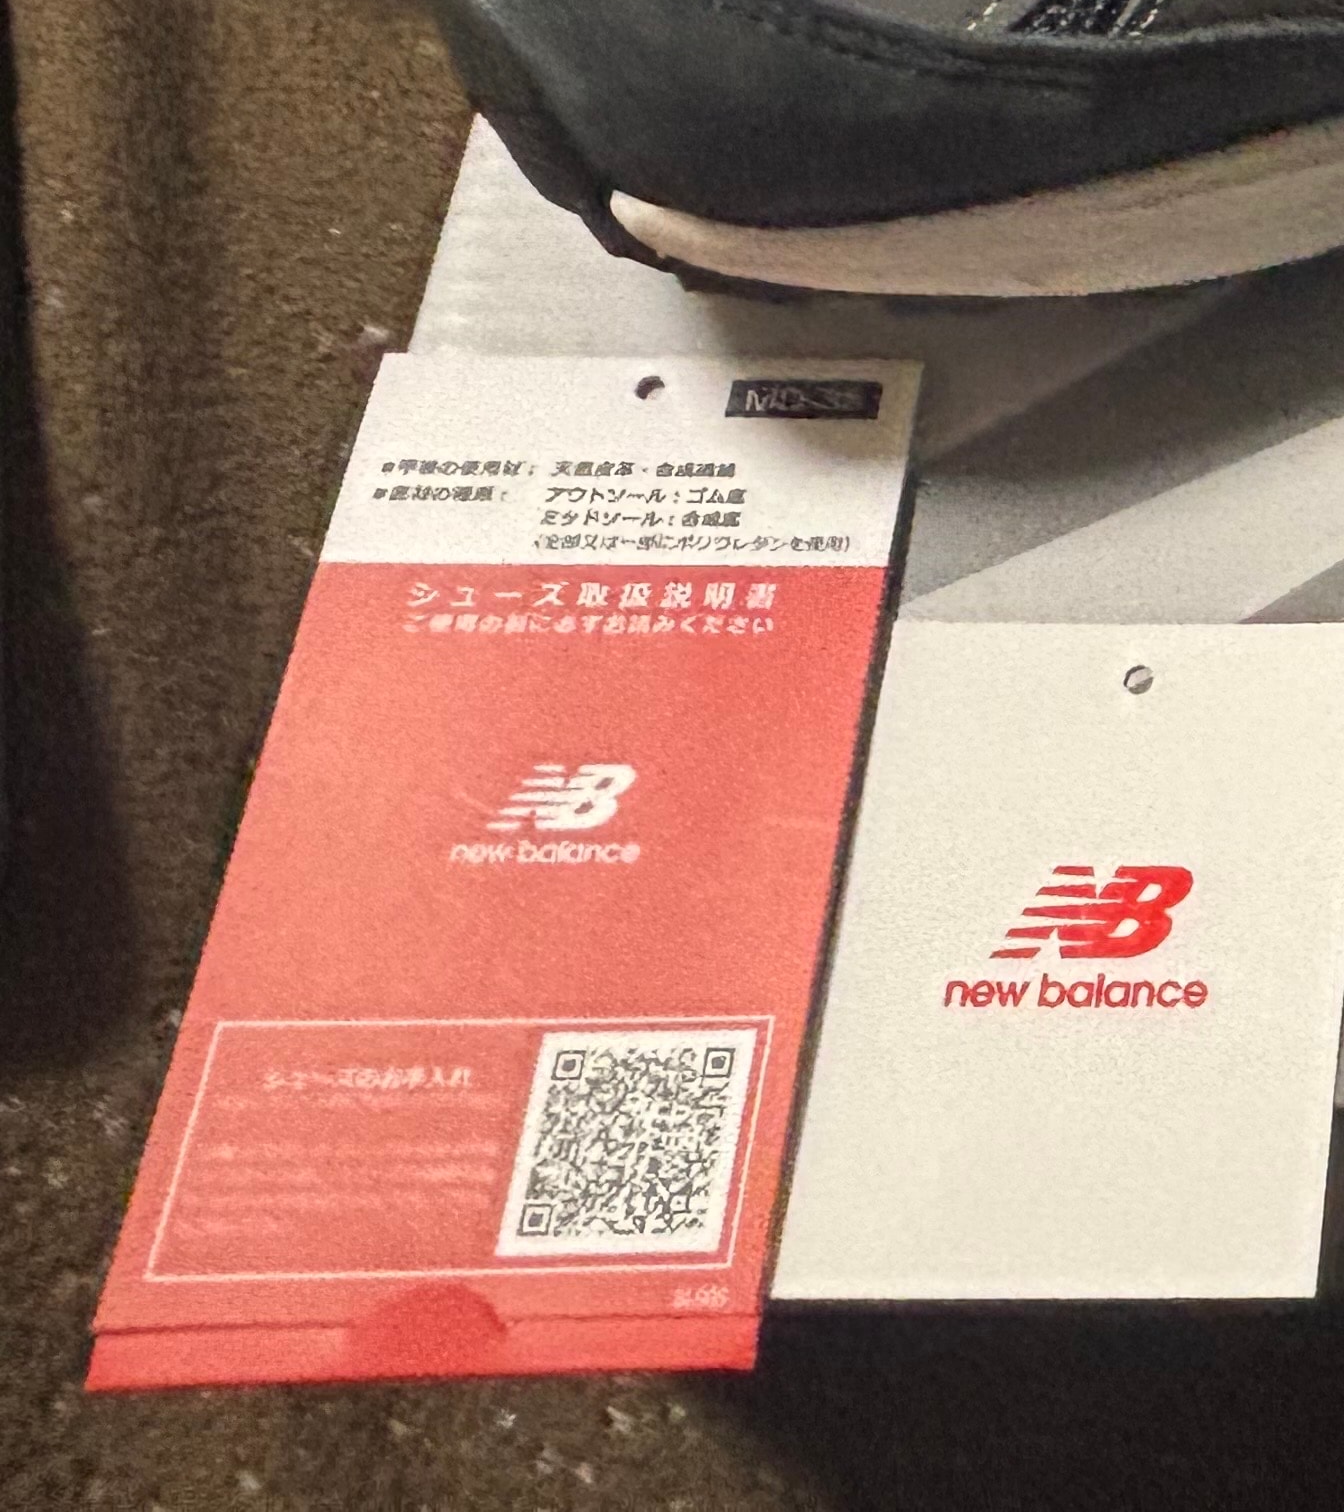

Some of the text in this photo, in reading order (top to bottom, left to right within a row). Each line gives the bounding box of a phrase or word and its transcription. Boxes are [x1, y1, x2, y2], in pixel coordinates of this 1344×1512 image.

[406, 581, 778, 609] シューズ取扱説明書
[516, 839, 641, 865] balance
[943, 973, 1208, 1008] new balance
